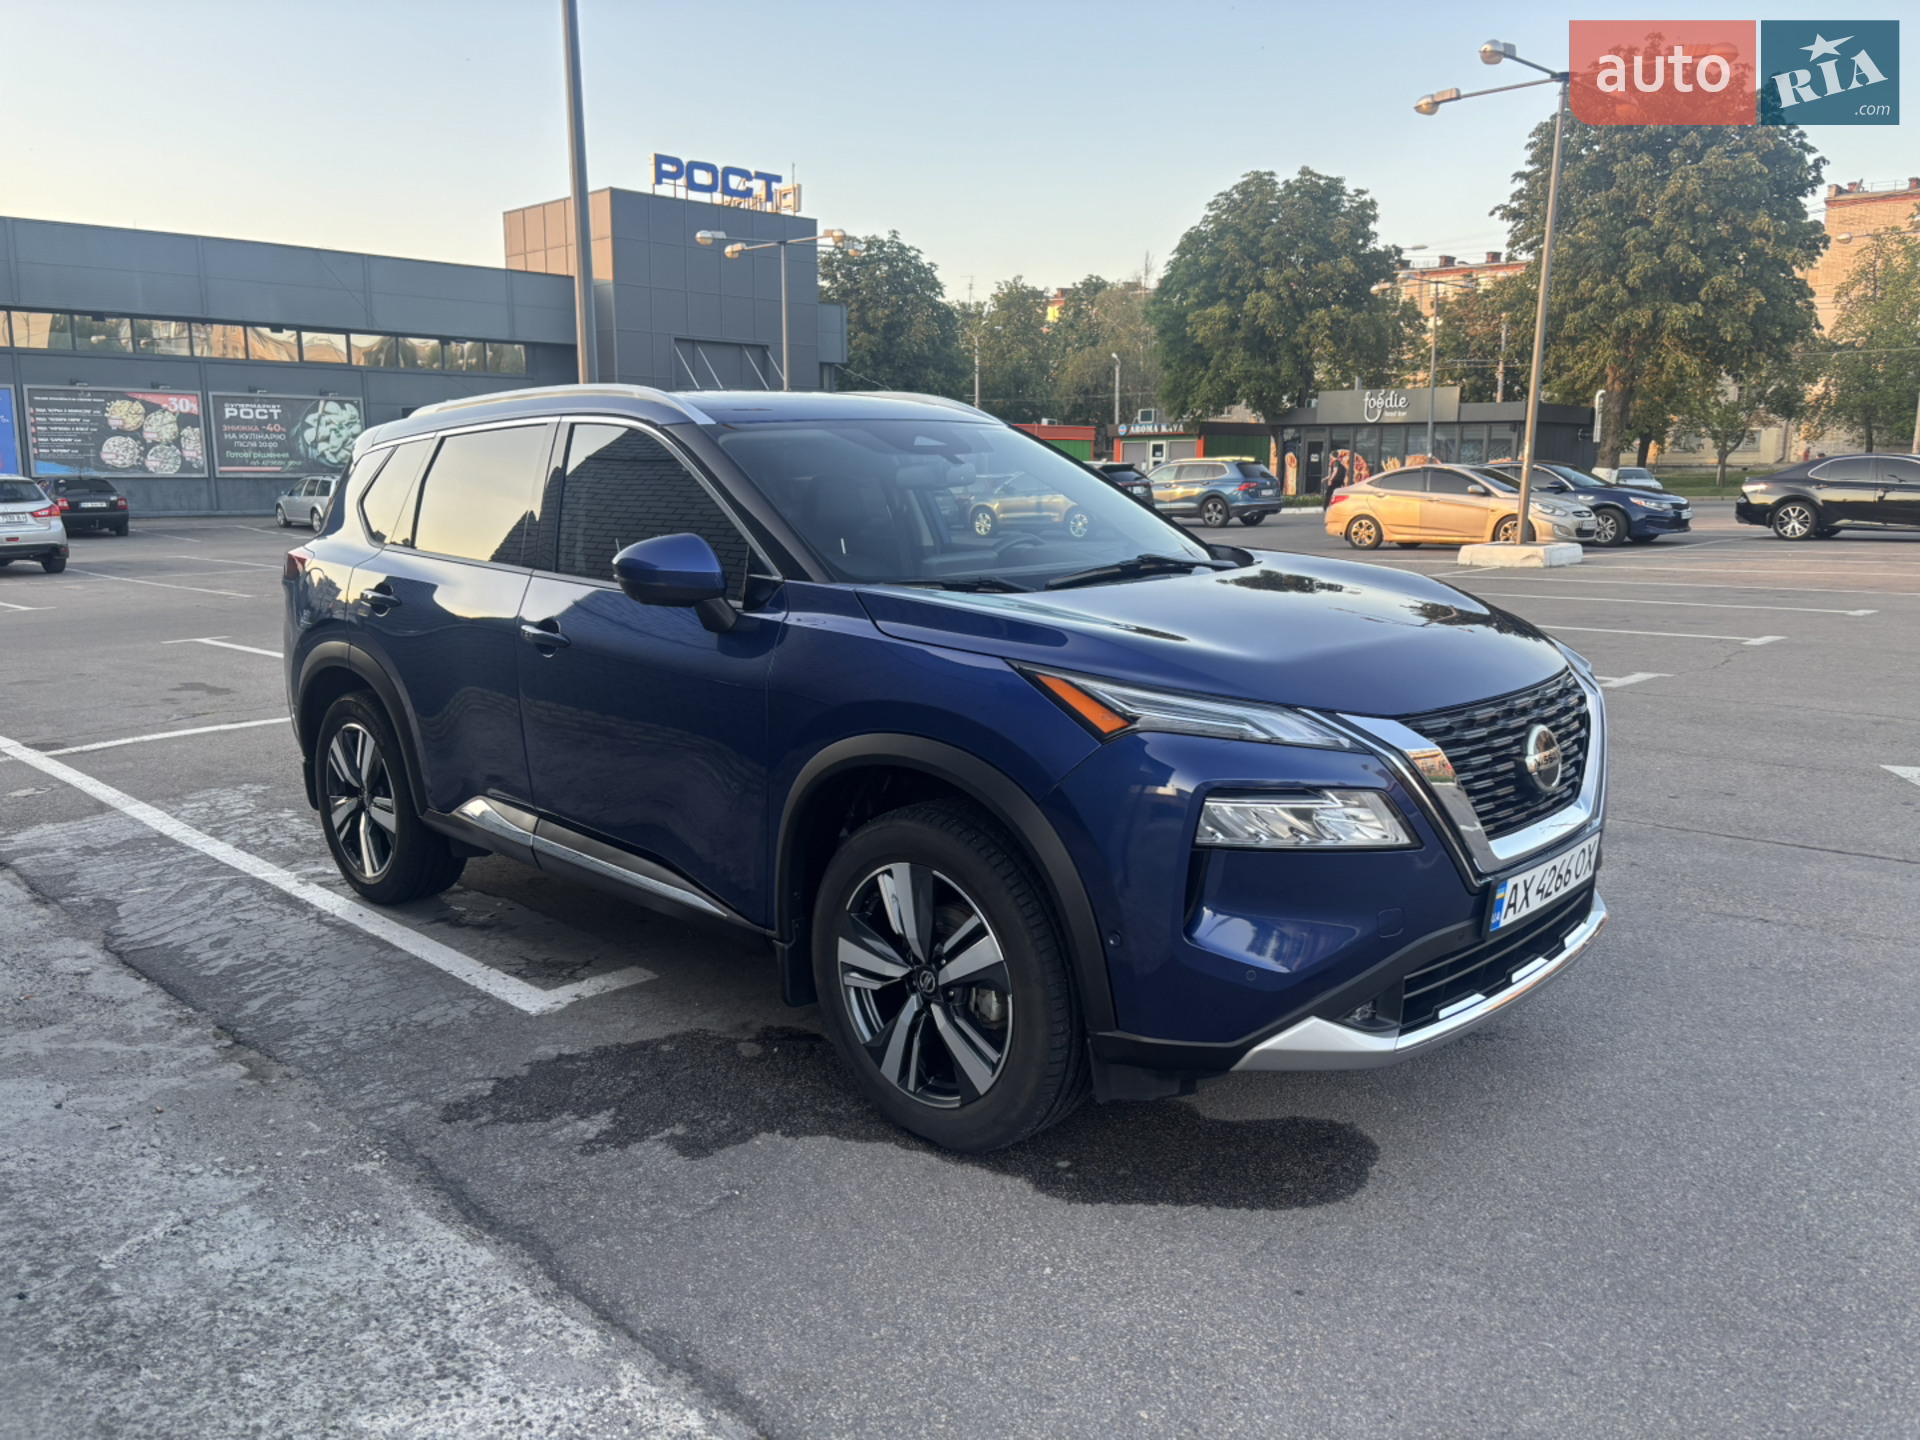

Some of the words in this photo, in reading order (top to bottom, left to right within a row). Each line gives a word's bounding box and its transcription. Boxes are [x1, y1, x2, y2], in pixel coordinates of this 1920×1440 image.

[651, 153, 783, 202] РОСТ
[1363, 389, 1409, 423] foodie
[224, 408, 282, 420] РОСТ
[222, 424, 260, 432] ЗНИЖКА
[1130, 424, 1159, 433] AROMA
[238, 433, 287, 441] КУЛІНАРІЮ
[1503, 875, 1535, 919] AX
[1535, 854, 1574, 901] 4266
[1574, 839, 1597, 879] OX
